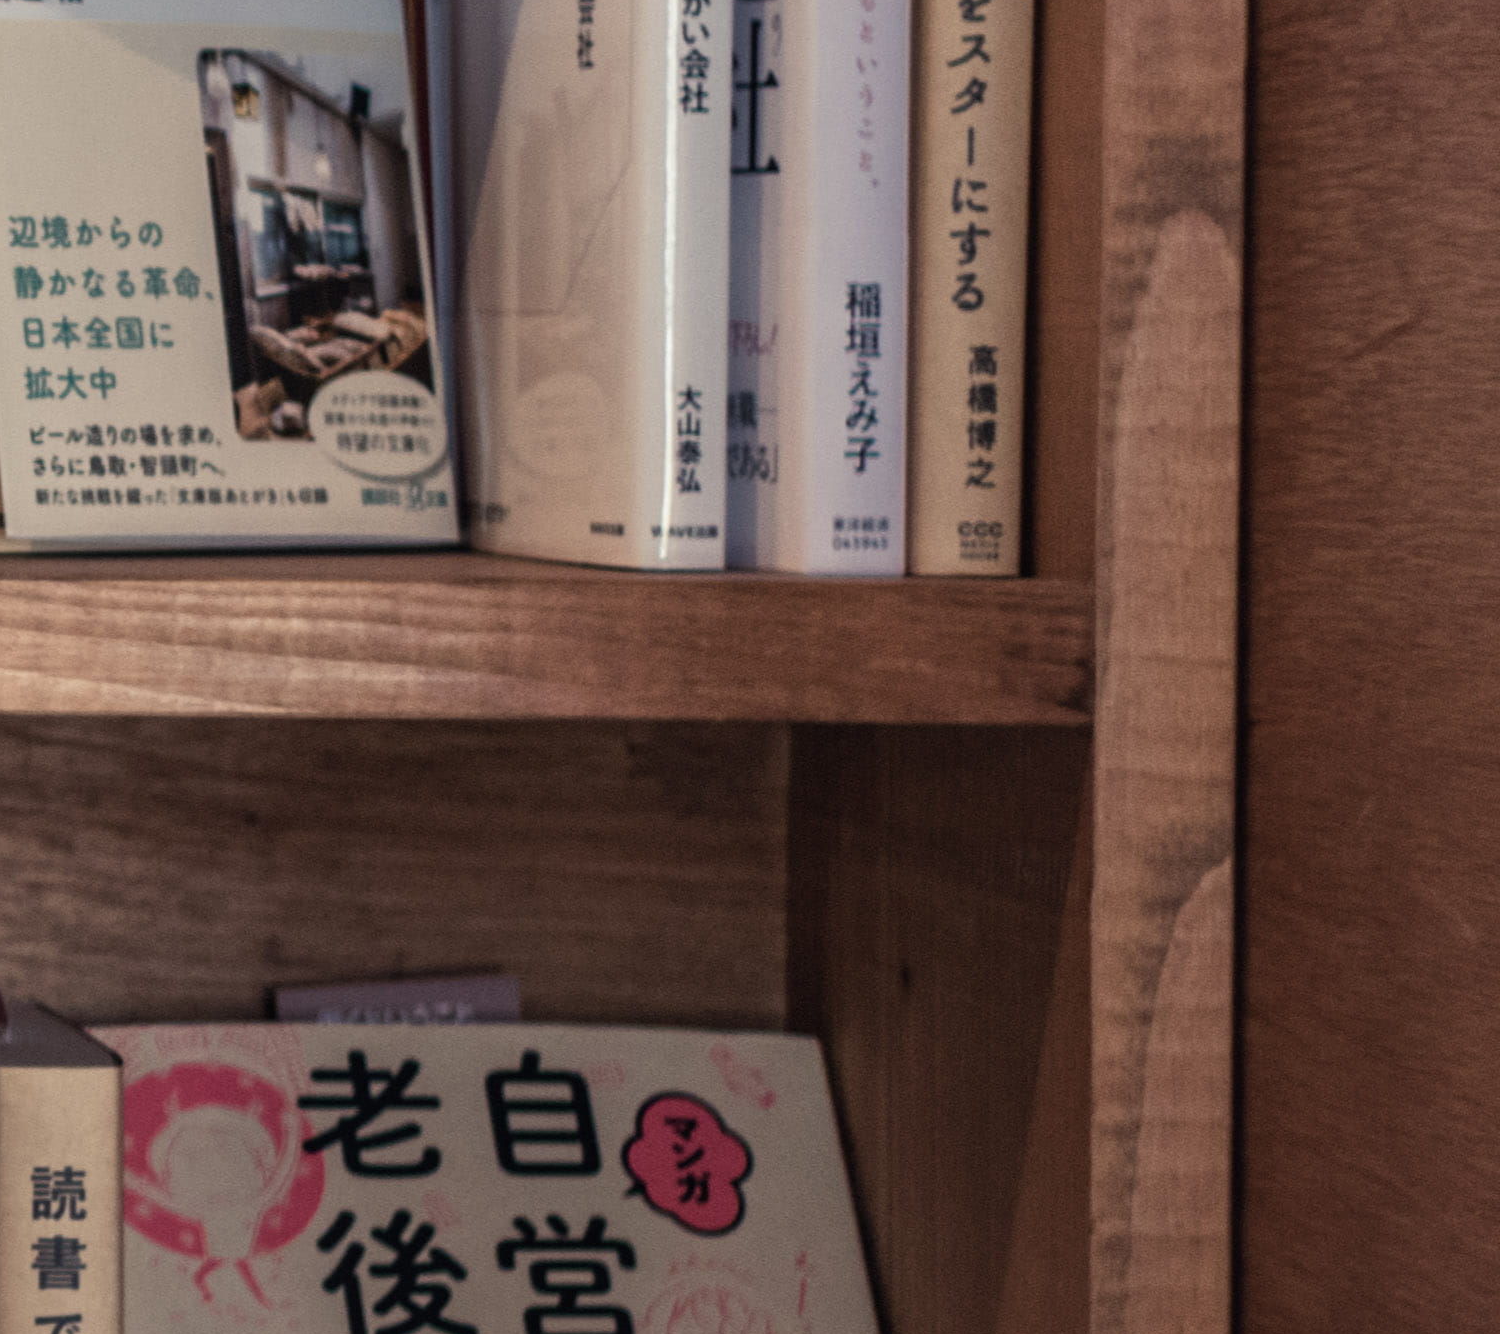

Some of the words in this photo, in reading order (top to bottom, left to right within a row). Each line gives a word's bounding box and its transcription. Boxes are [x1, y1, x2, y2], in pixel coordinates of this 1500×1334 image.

[8, 214, 164, 250] 辺境からの
[13, 264, 216, 301] 静かなる革命、
[22, 315, 175, 351] 日本全国に
[24, 367, 119, 401] 拡大中
[843, 281, 882, 475] 稲垣えみ子
[29, 424, 223, 448] ビール造りの場を求め、
[676, 384, 703, 495] 大山泰弘
[662, 1114, 714, 1208] マンガ
